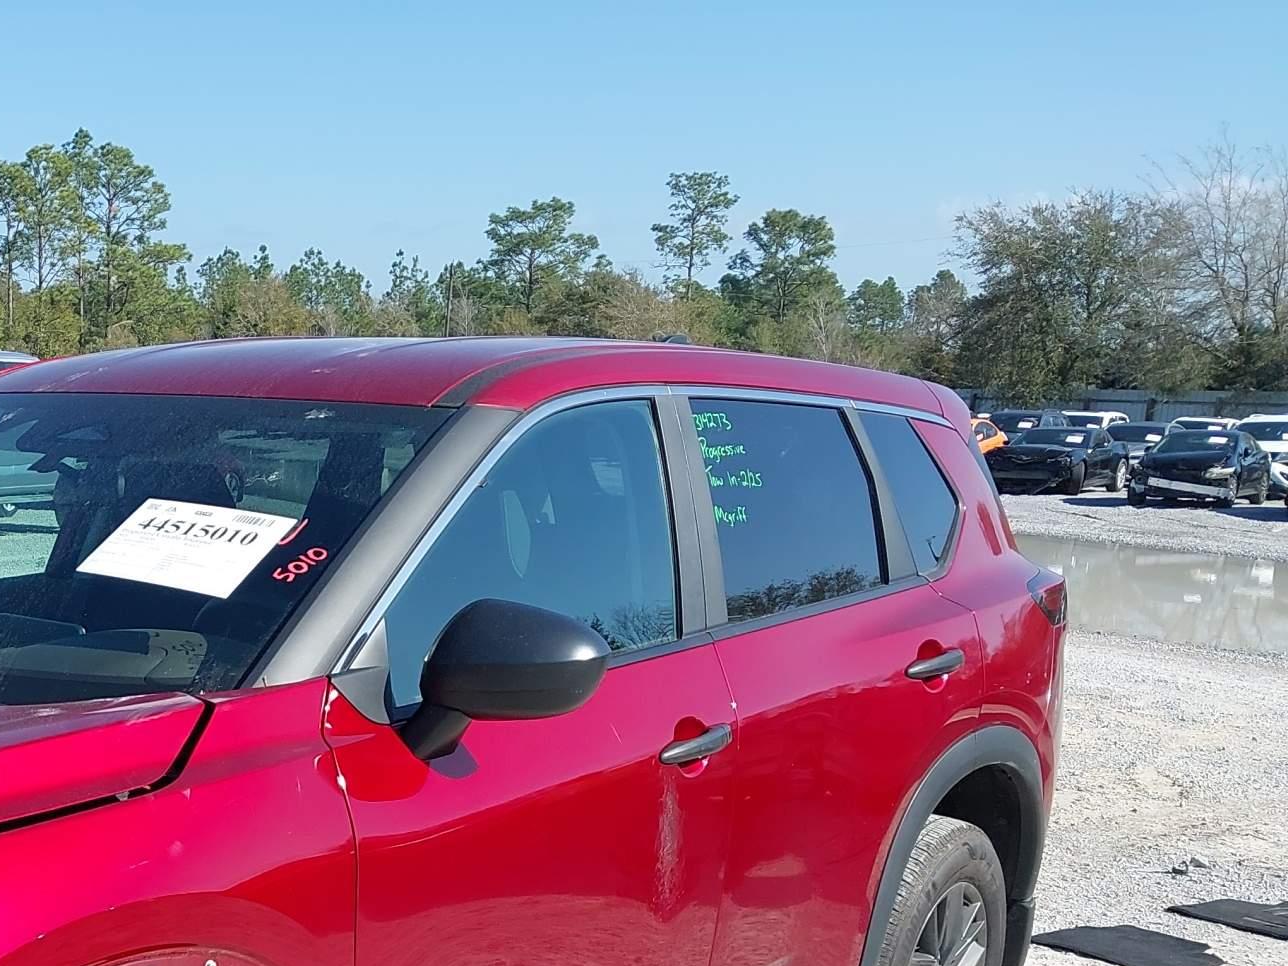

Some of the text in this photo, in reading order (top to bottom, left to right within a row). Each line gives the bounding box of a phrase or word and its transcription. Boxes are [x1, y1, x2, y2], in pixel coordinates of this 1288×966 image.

[697, 436, 747, 463] Progressive
[137, 515, 259, 546] 44515010
[271, 546, 329, 583] 5010
